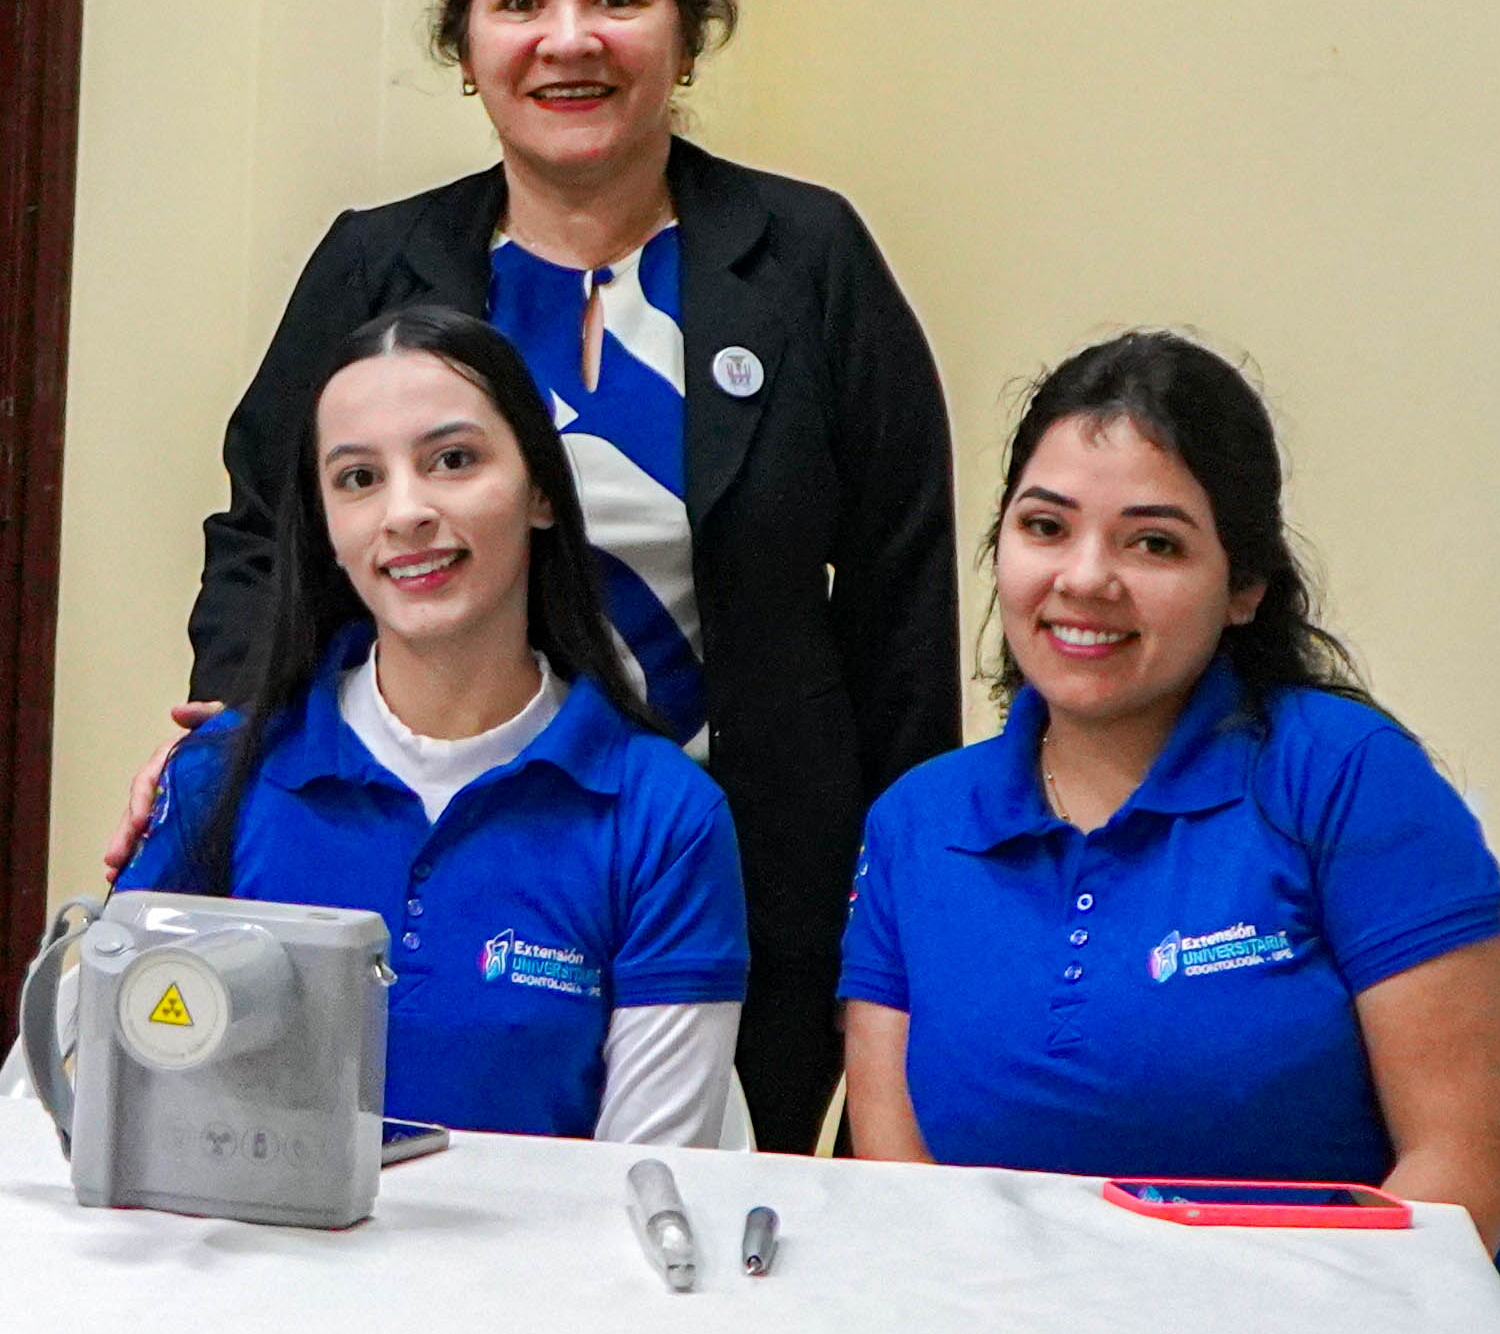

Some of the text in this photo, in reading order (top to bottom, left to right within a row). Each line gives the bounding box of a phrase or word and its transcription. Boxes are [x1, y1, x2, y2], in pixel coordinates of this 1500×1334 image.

[1181, 922, 1256, 951] Extensión
[1183, 935, 1289, 965] UNIVERSITARIA
[514, 941, 584, 964] Extensión
